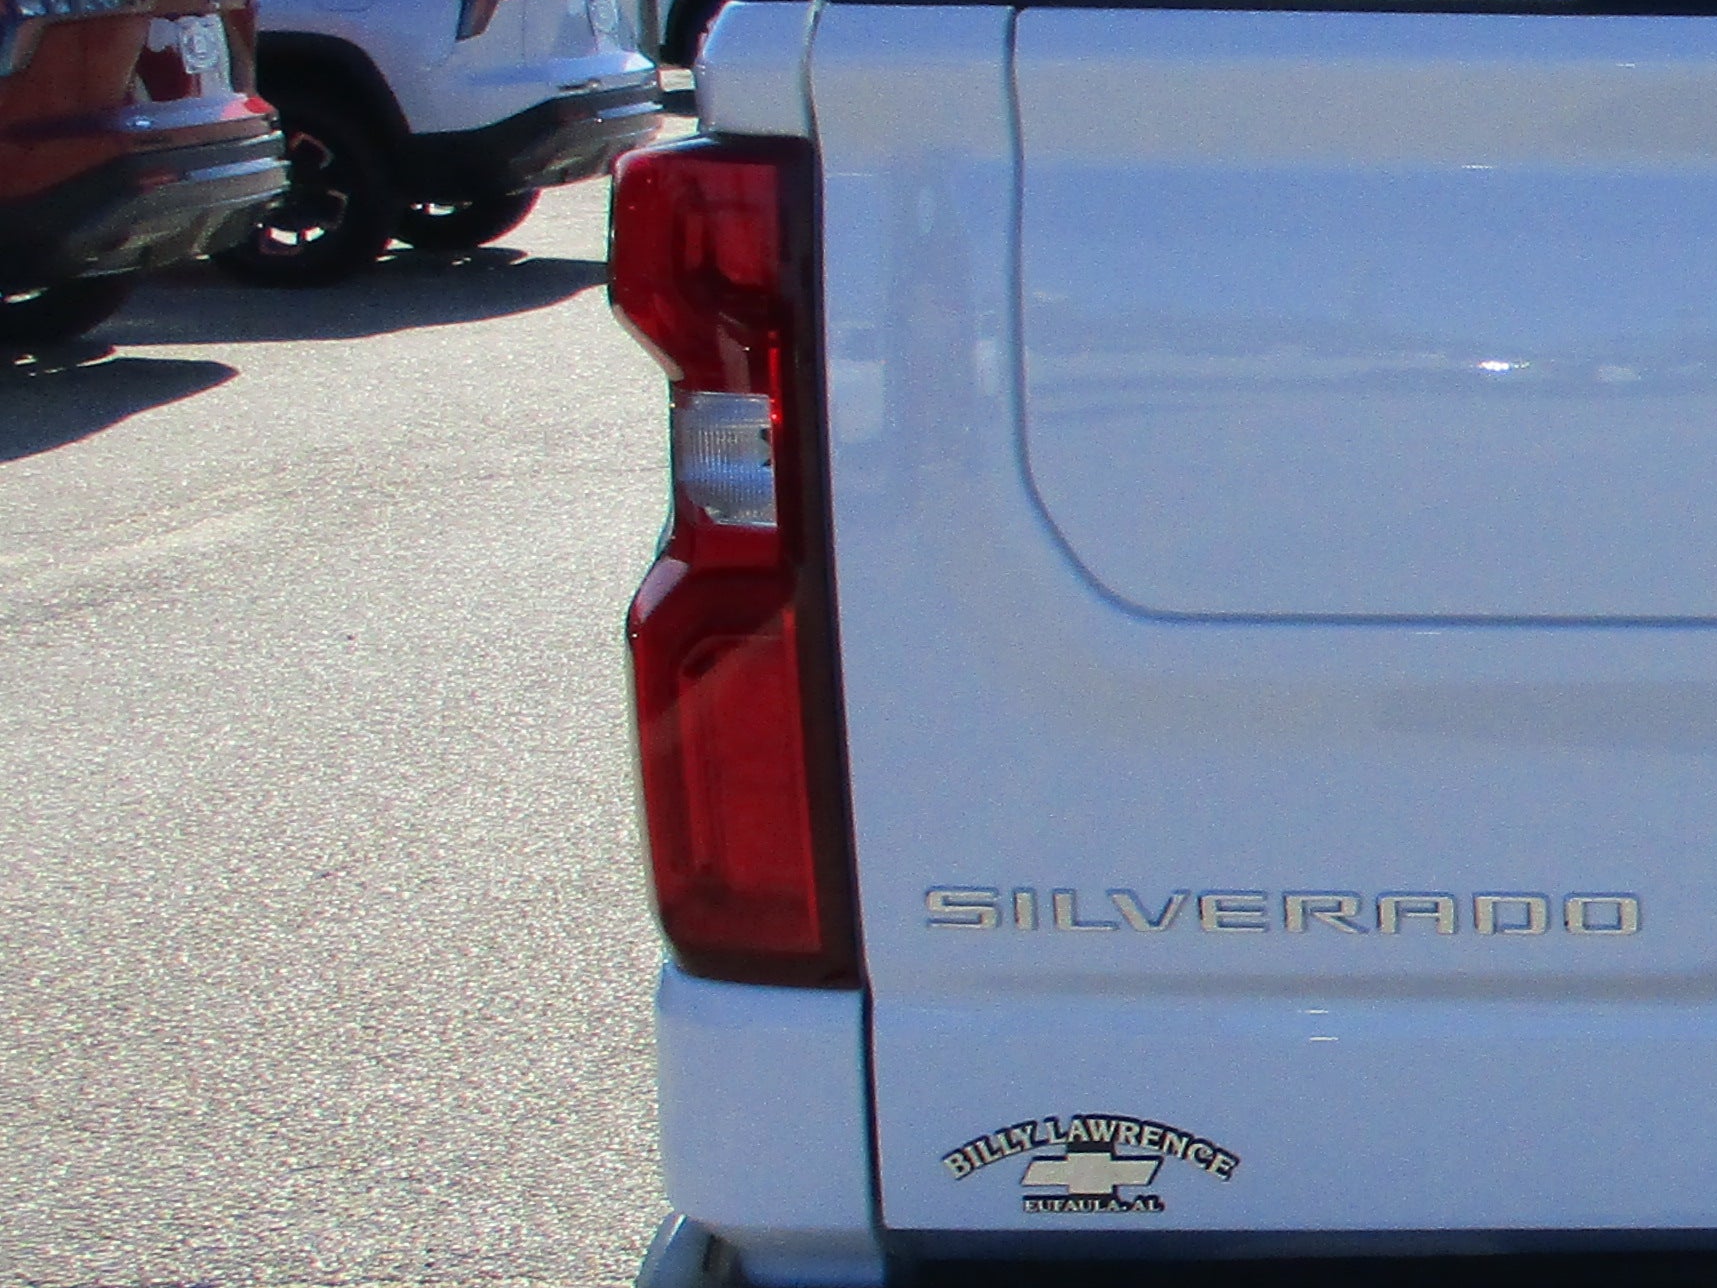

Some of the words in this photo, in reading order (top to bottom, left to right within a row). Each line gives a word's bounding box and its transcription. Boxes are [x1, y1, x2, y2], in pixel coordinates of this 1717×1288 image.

[924, 886, 1642, 936] SILVERADO
[942, 1118, 1038, 1180] BILLY
[1045, 1113, 1241, 1182] LAWRENCE
[1132, 1196, 1165, 1213] AL
